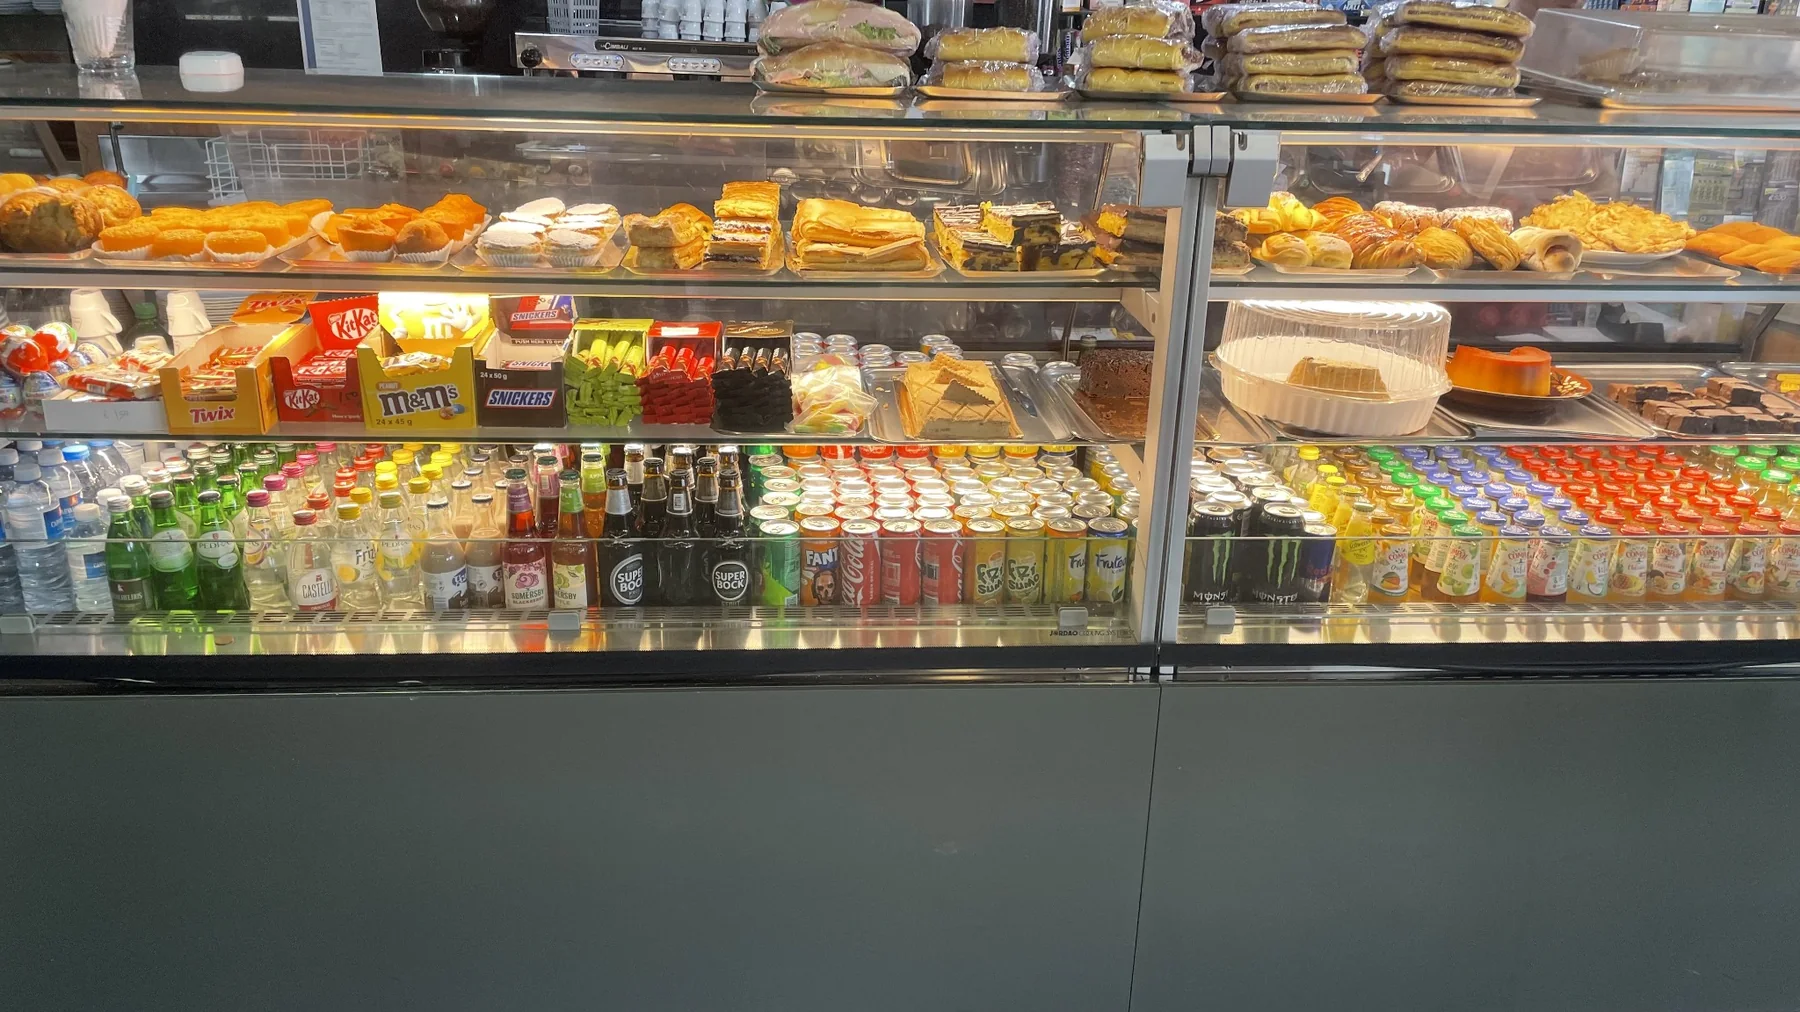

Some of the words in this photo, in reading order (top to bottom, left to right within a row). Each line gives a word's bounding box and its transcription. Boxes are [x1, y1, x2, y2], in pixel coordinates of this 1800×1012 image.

[335, 308, 378, 340] KitKat
[512, 310, 558, 321] SNICKERS
[285, 388, 320, 409] KitKat
[488, 390, 553, 406] SNICKERS
[190, 406, 235, 424] Twix
[355, 545, 379, 566] Friz
[805, 547, 839, 566] FANT
[617, 565, 643, 583] SUPE
[715, 570, 746, 581] SUPER
[302, 578, 334, 599] CASTELL
[511, 588, 544, 600] SOMERSBY
[620, 578, 643, 593] BOC
[716, 580, 745, 590] BOCK
